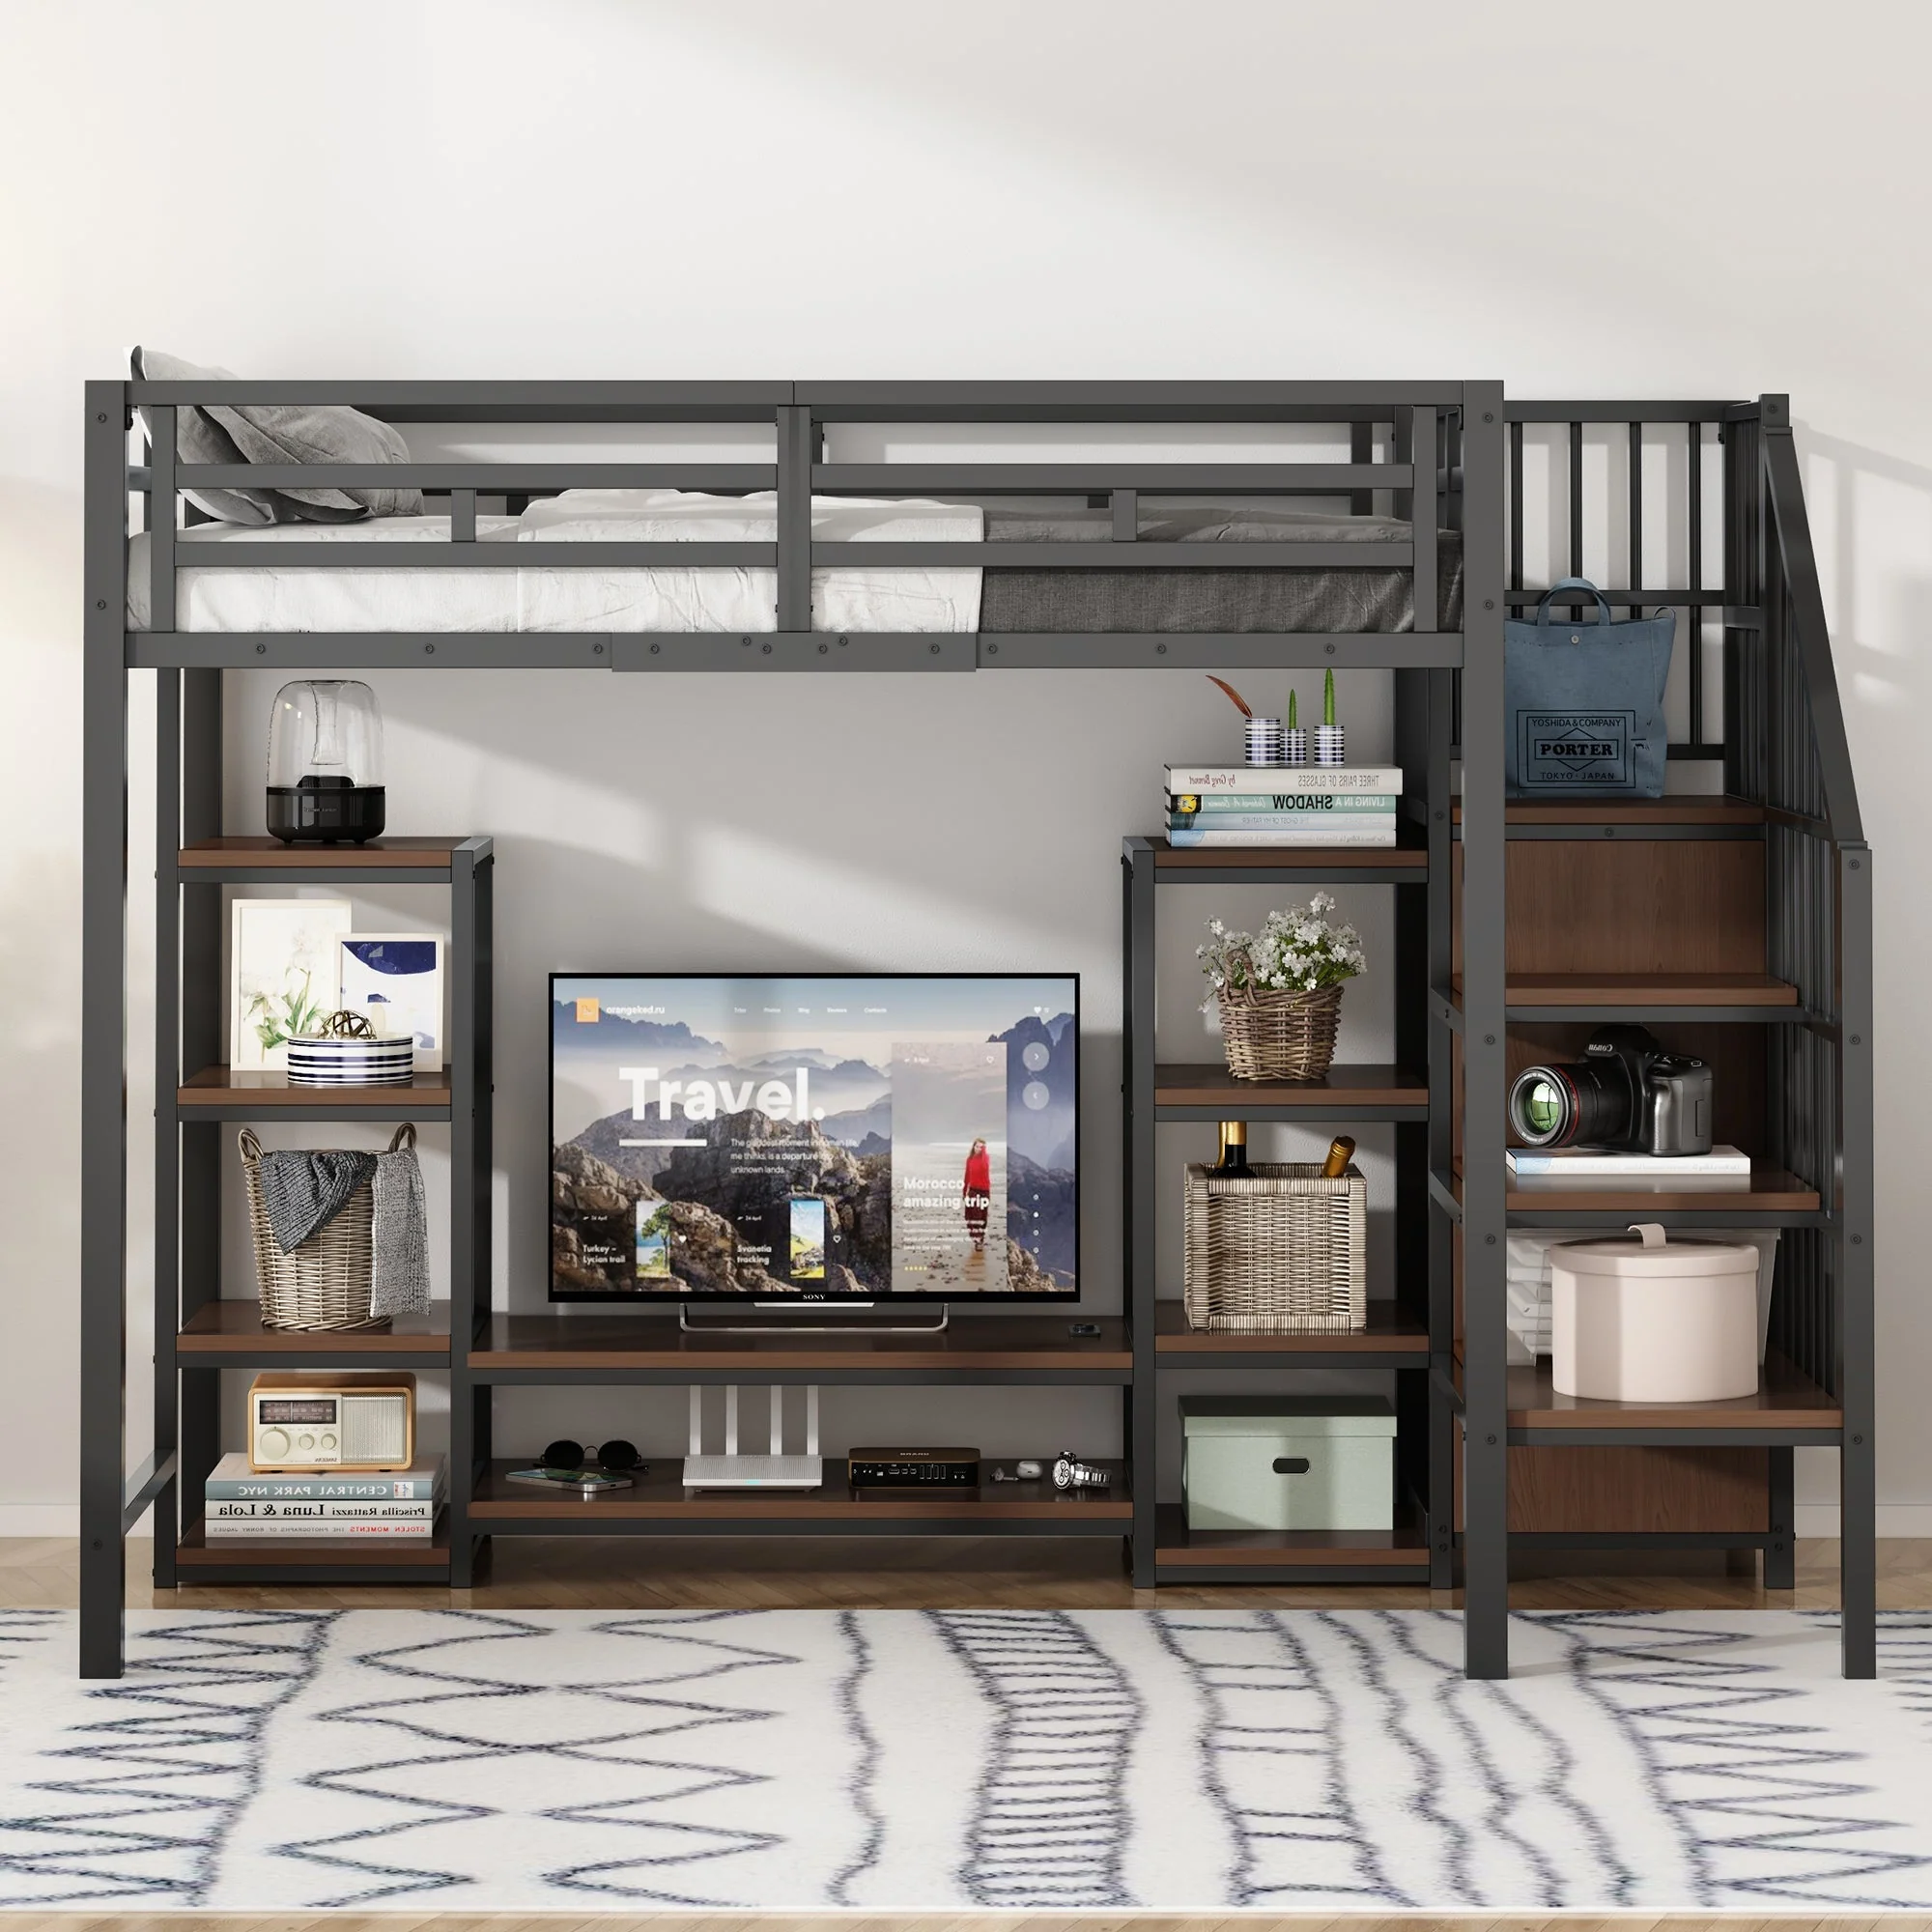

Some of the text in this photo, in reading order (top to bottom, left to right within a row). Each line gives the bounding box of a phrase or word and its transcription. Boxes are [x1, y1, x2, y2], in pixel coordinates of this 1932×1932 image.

[1540, 743, 1613, 755] PORTER
[1541, 772, 1615, 781] TOKYO JAPAN
[606, 1005, 666, 1015] orangeked.ru
[618, 1066, 826, 1122] Travel.
[730, 1138, 745, 1147] The
[781, 1151, 818, 1161] departure
[903, 1178, 965, 1190] Morocco
[903, 1195, 990, 1209] amazing trip
[582, 1244, 611, 1255] Turkey
[737, 1244, 772, 1253] Svanetia
[582, 1255, 626, 1265] Lycian trail
[737, 1255, 770, 1265] tracking
